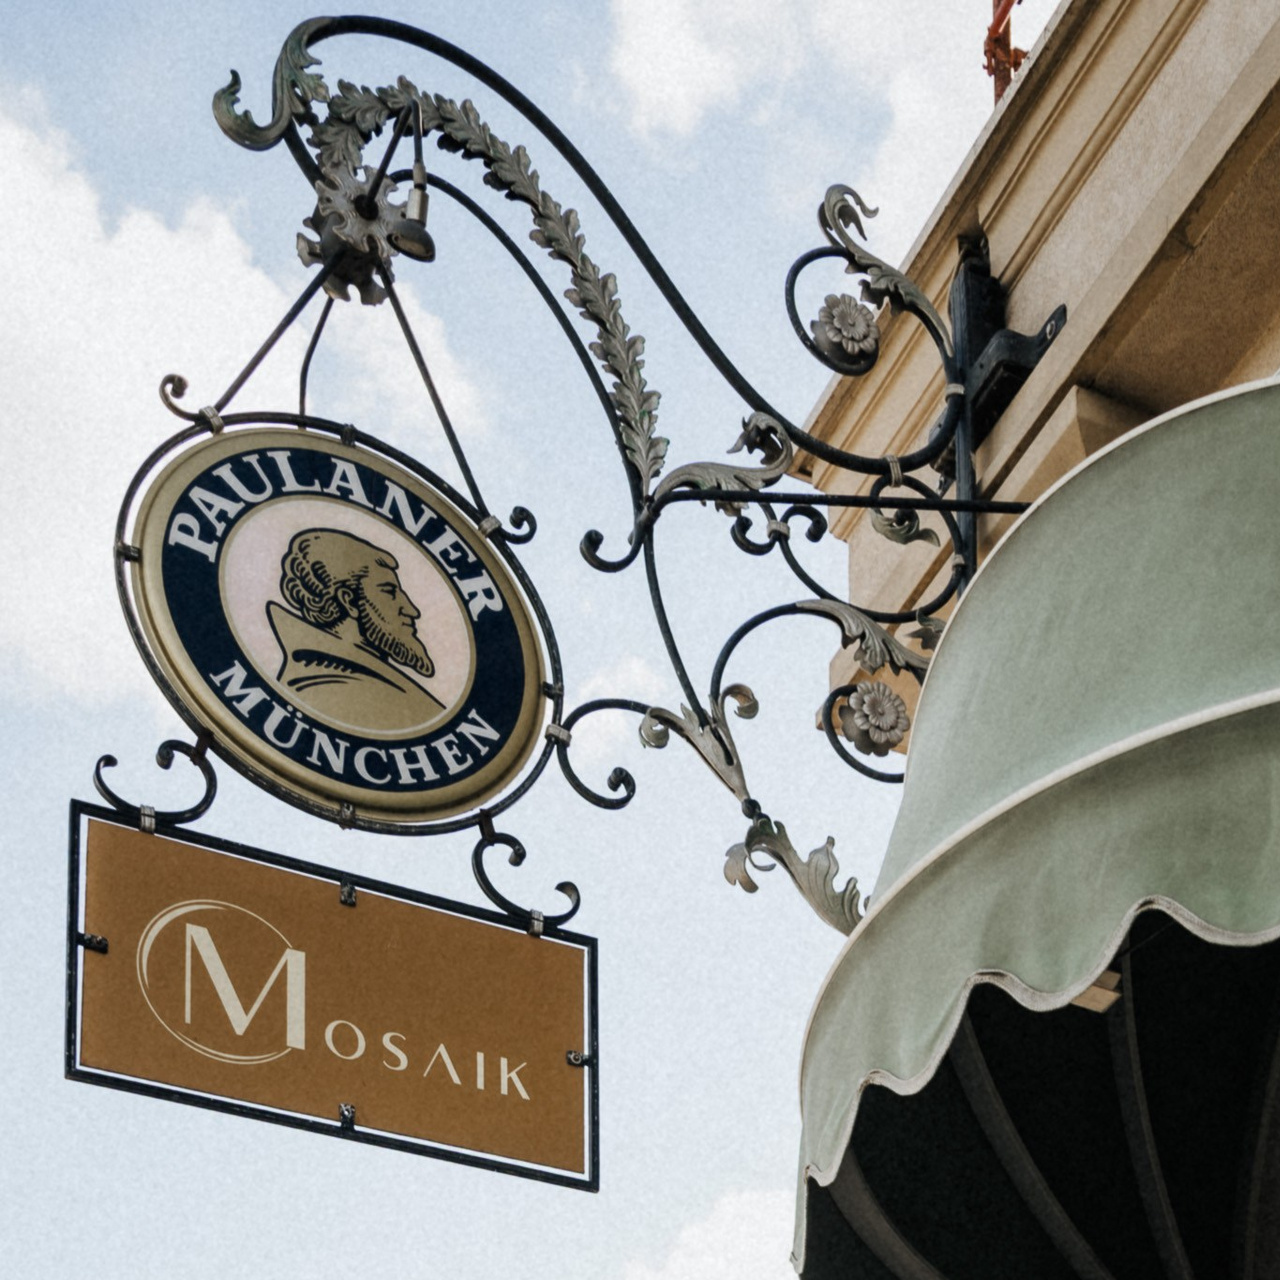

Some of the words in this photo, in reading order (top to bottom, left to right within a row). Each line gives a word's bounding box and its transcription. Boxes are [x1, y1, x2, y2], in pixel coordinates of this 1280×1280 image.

[168, 450, 504, 621] PAULANER
[209, 660, 501, 785] MÜNCHEN
[184, 922, 531, 1100] MOSAIK
